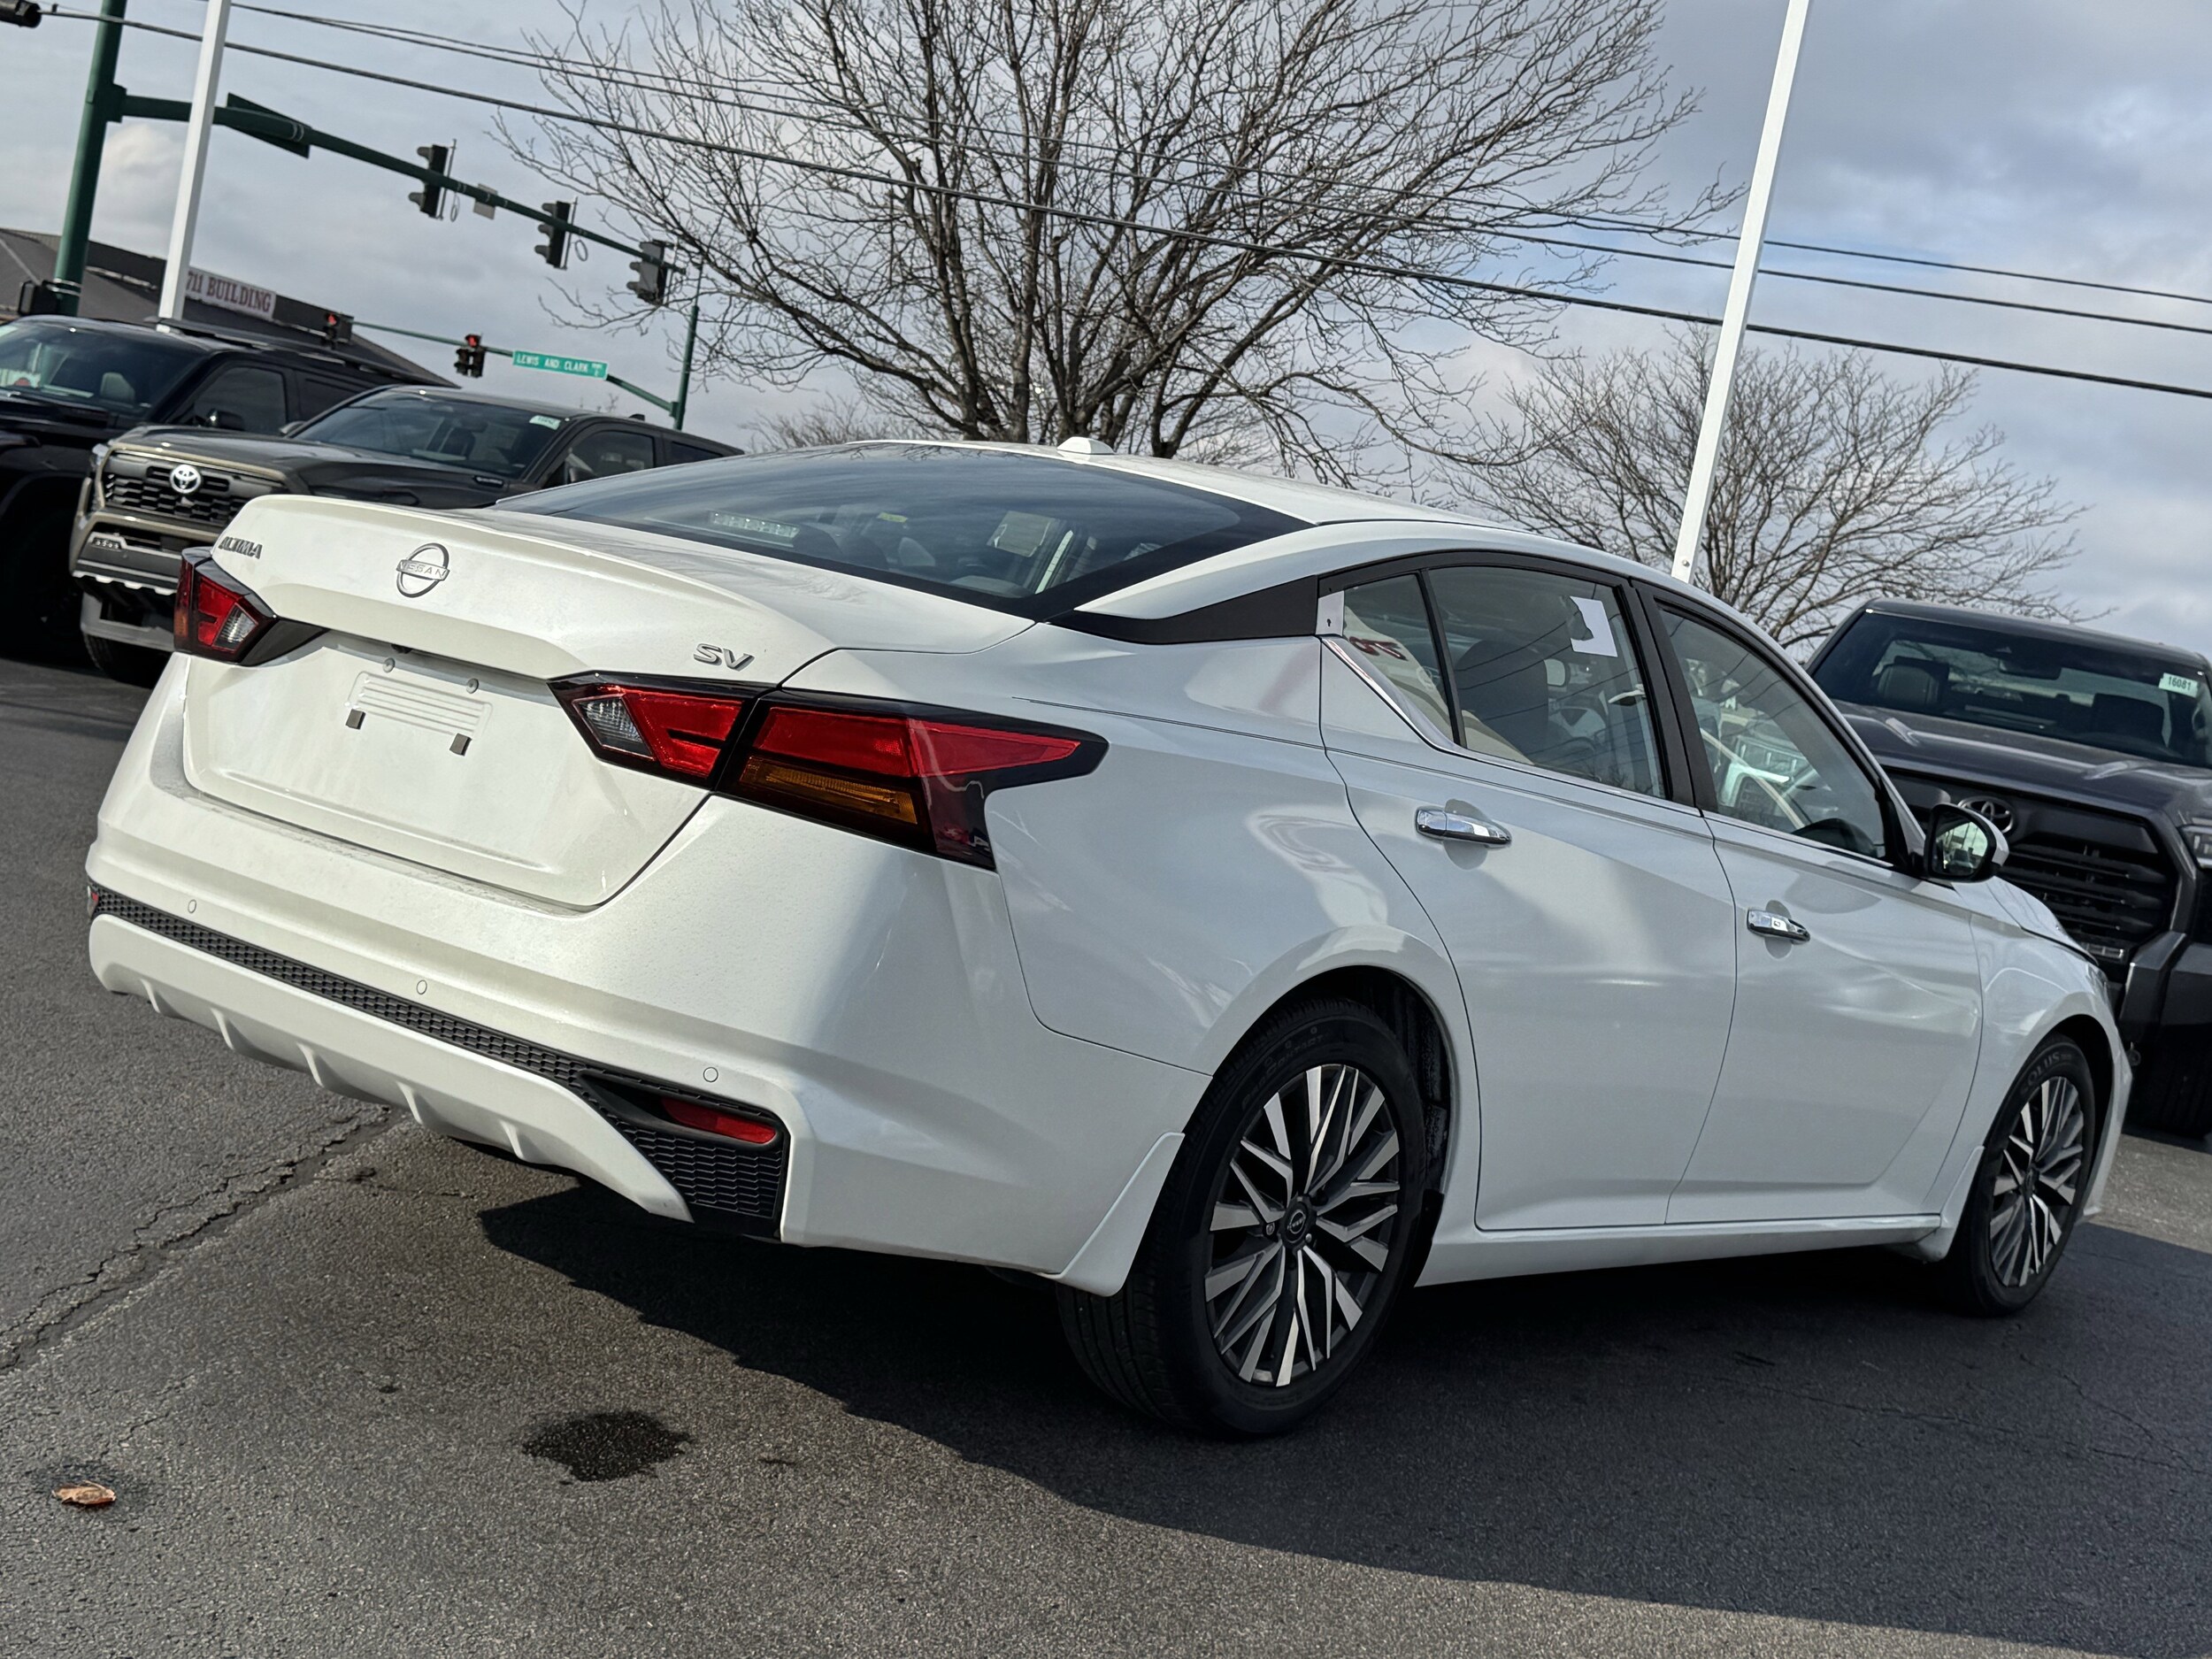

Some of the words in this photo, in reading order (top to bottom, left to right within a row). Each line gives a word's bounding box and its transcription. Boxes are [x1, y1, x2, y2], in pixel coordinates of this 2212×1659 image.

[207, 277, 272, 312] BUILDING
[517, 354, 540, 366] LEWIS
[544, 358, 559, 369] AND
[565, 361, 588, 373] CLARK
[218, 536, 263, 559] ALTIMA
[693, 643, 755, 672] SV
